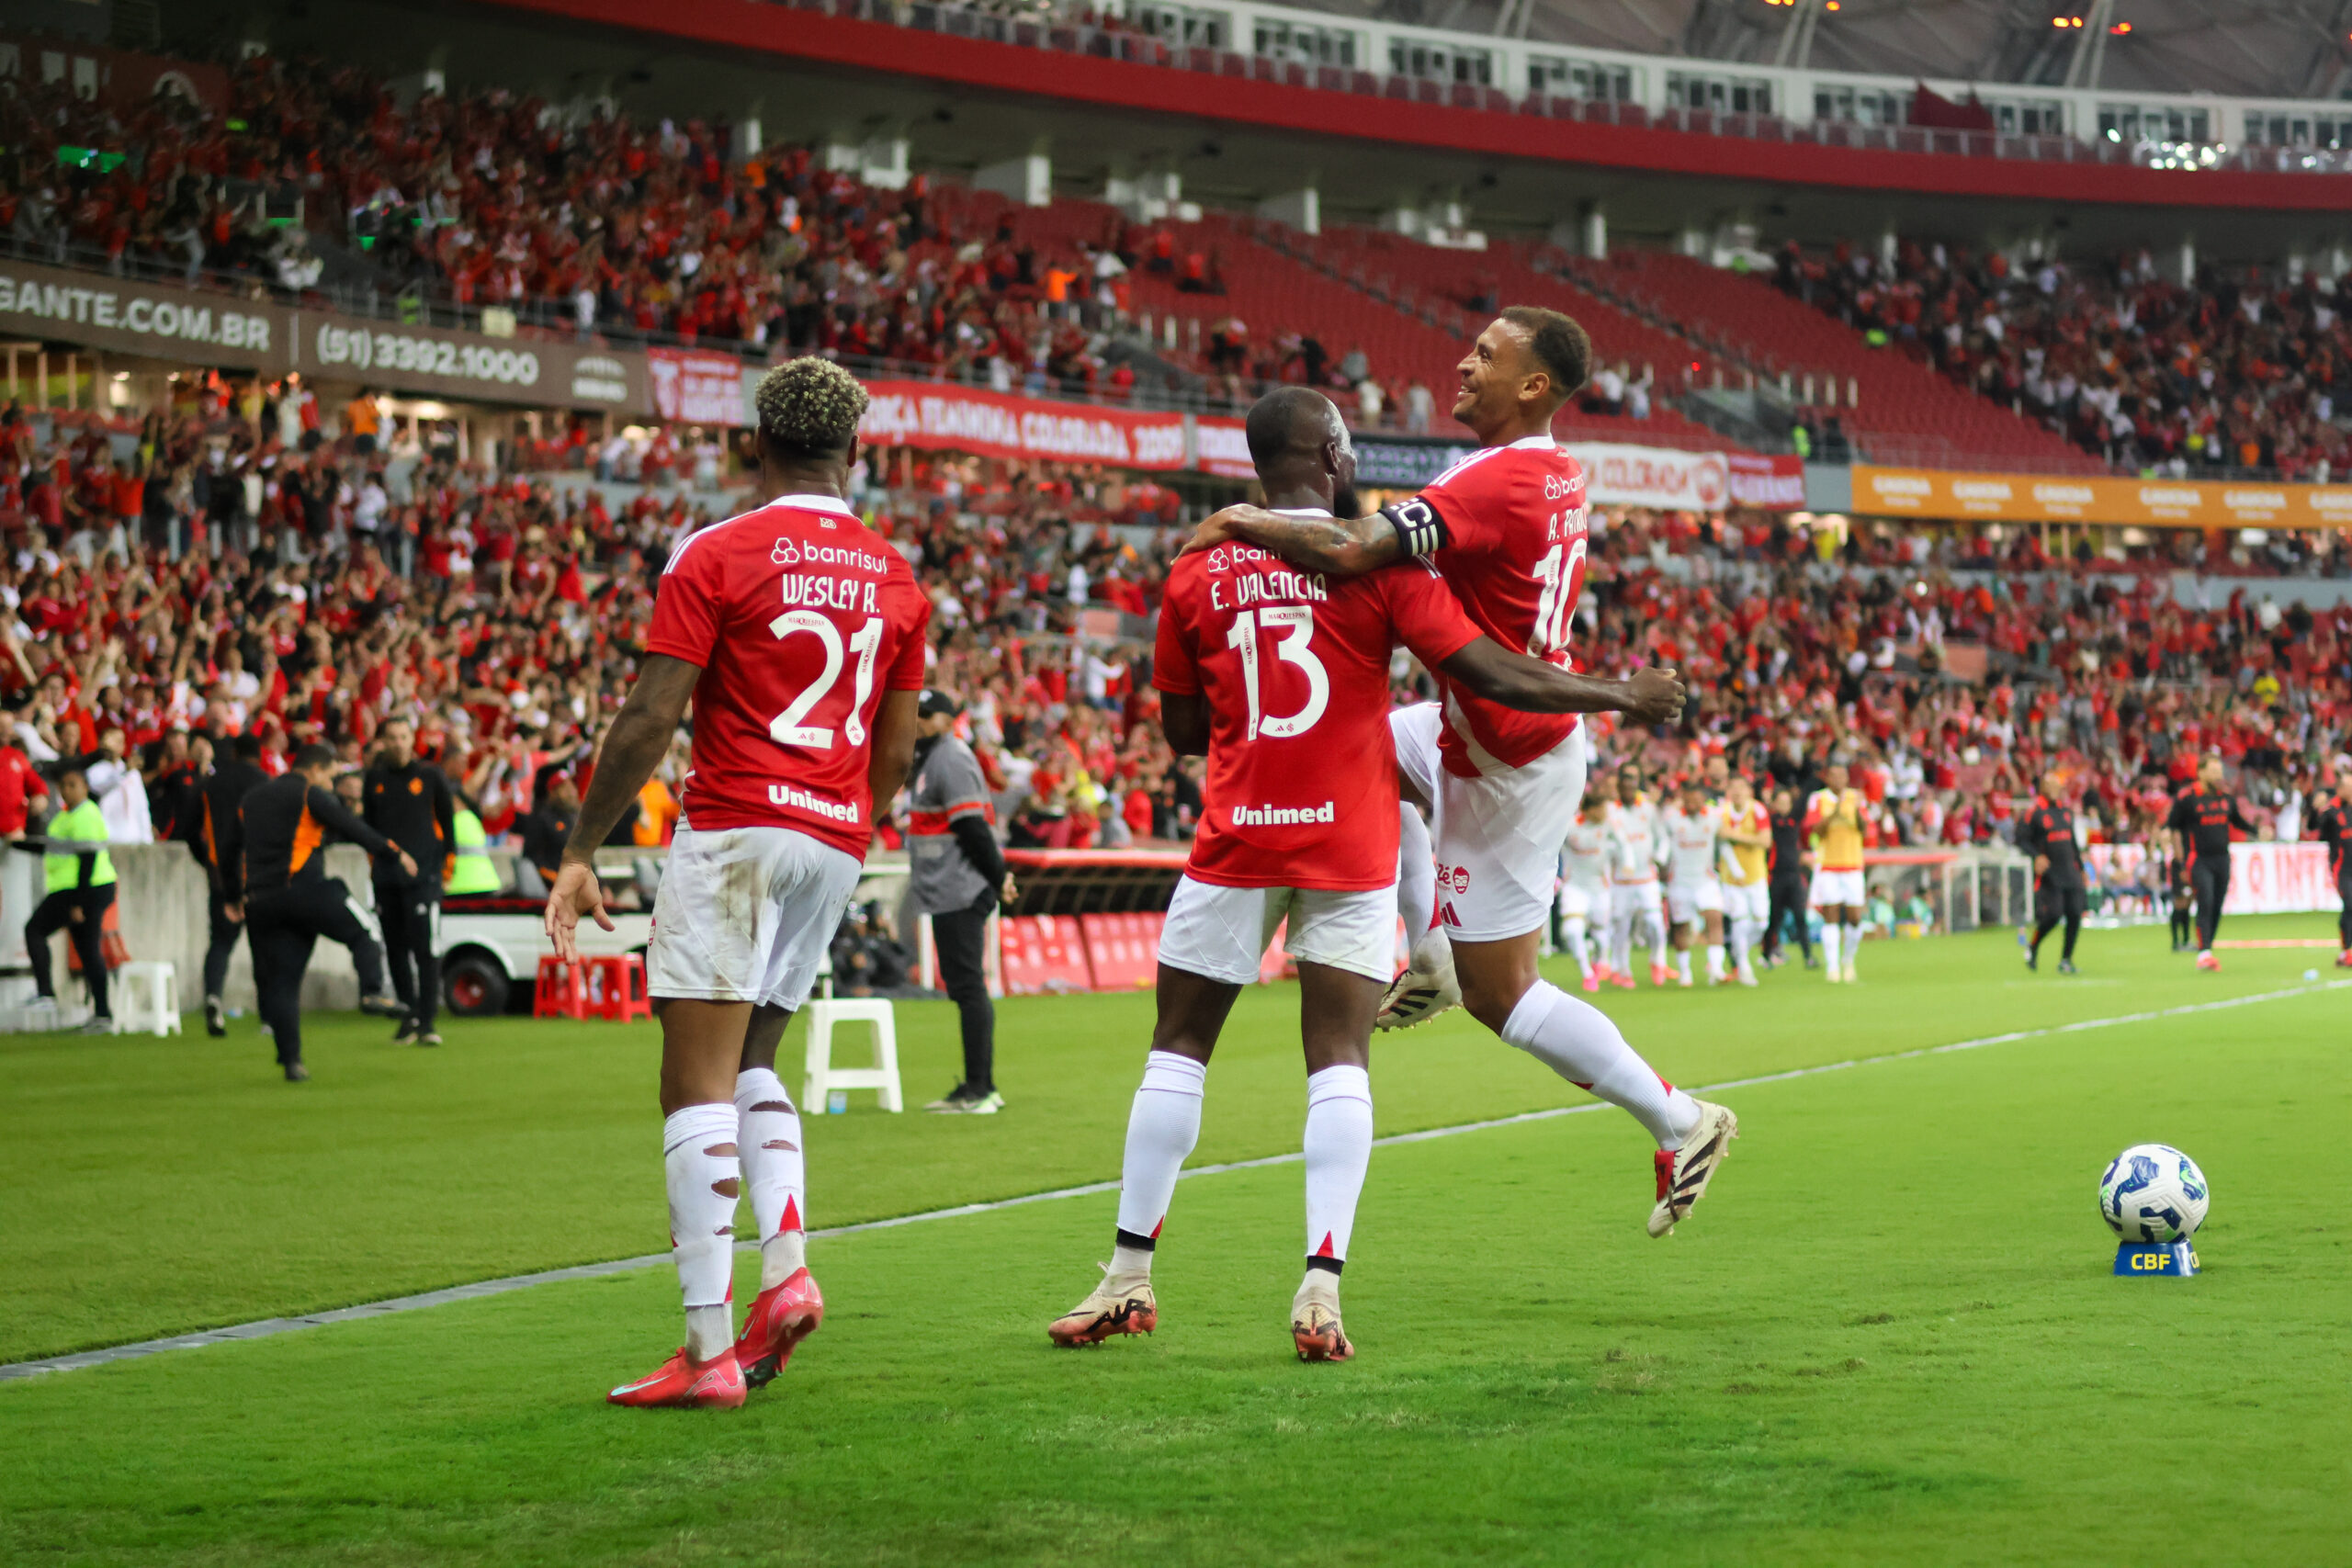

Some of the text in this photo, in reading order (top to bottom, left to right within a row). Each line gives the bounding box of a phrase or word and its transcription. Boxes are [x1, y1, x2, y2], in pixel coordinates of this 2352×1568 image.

[317, 321, 540, 387] (51) 3392.1000
[803, 538, 888, 575] banrisul
[782, 572, 881, 614] WESLEY R.
[1211, 570, 1329, 611] E. VALENCIA
[1527, 537, 1588, 658] 10
[768, 609, 884, 750] 21
[1226, 604, 1330, 742] 13
[768, 784, 859, 824] Unimed
[1231, 800, 1335, 826] Unimed
[2131, 1254, 2171, 1270] CBF
